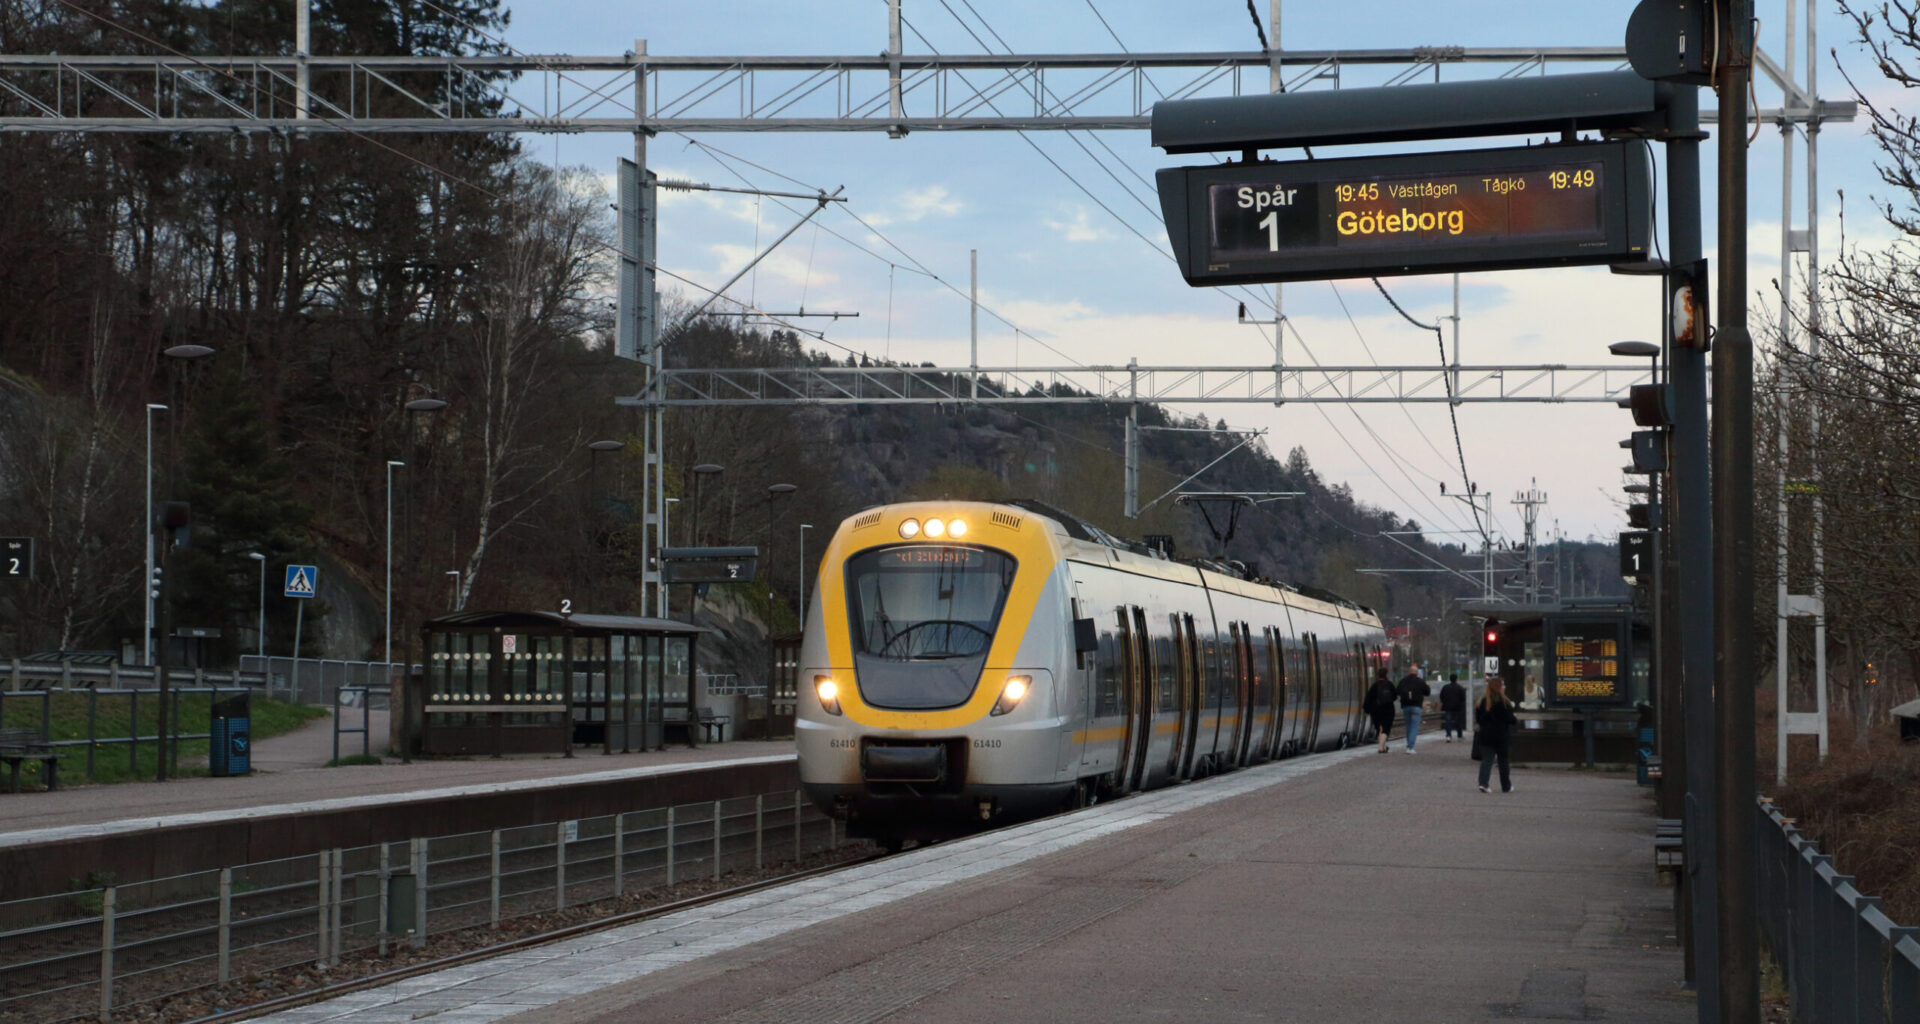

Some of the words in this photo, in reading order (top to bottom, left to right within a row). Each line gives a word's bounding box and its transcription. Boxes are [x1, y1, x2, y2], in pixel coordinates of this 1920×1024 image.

[1335, 183, 1379, 202] 19:45
[1388, 182, 1458, 199] Västtågen
[1549, 169, 1595, 190] 19:49
[1237, 184, 1298, 213] Spår
[1336, 208, 1464, 235] Göteborg
[1259, 211, 1279, 252] 1
[9, 558, 19, 574] 2
[1632, 553, 1640, 570] 1
[730, 569, 737, 578] 2
[561, 599, 571, 613] 2
[830, 739, 856, 748] 61410
[974, 739, 1002, 748] 61410
